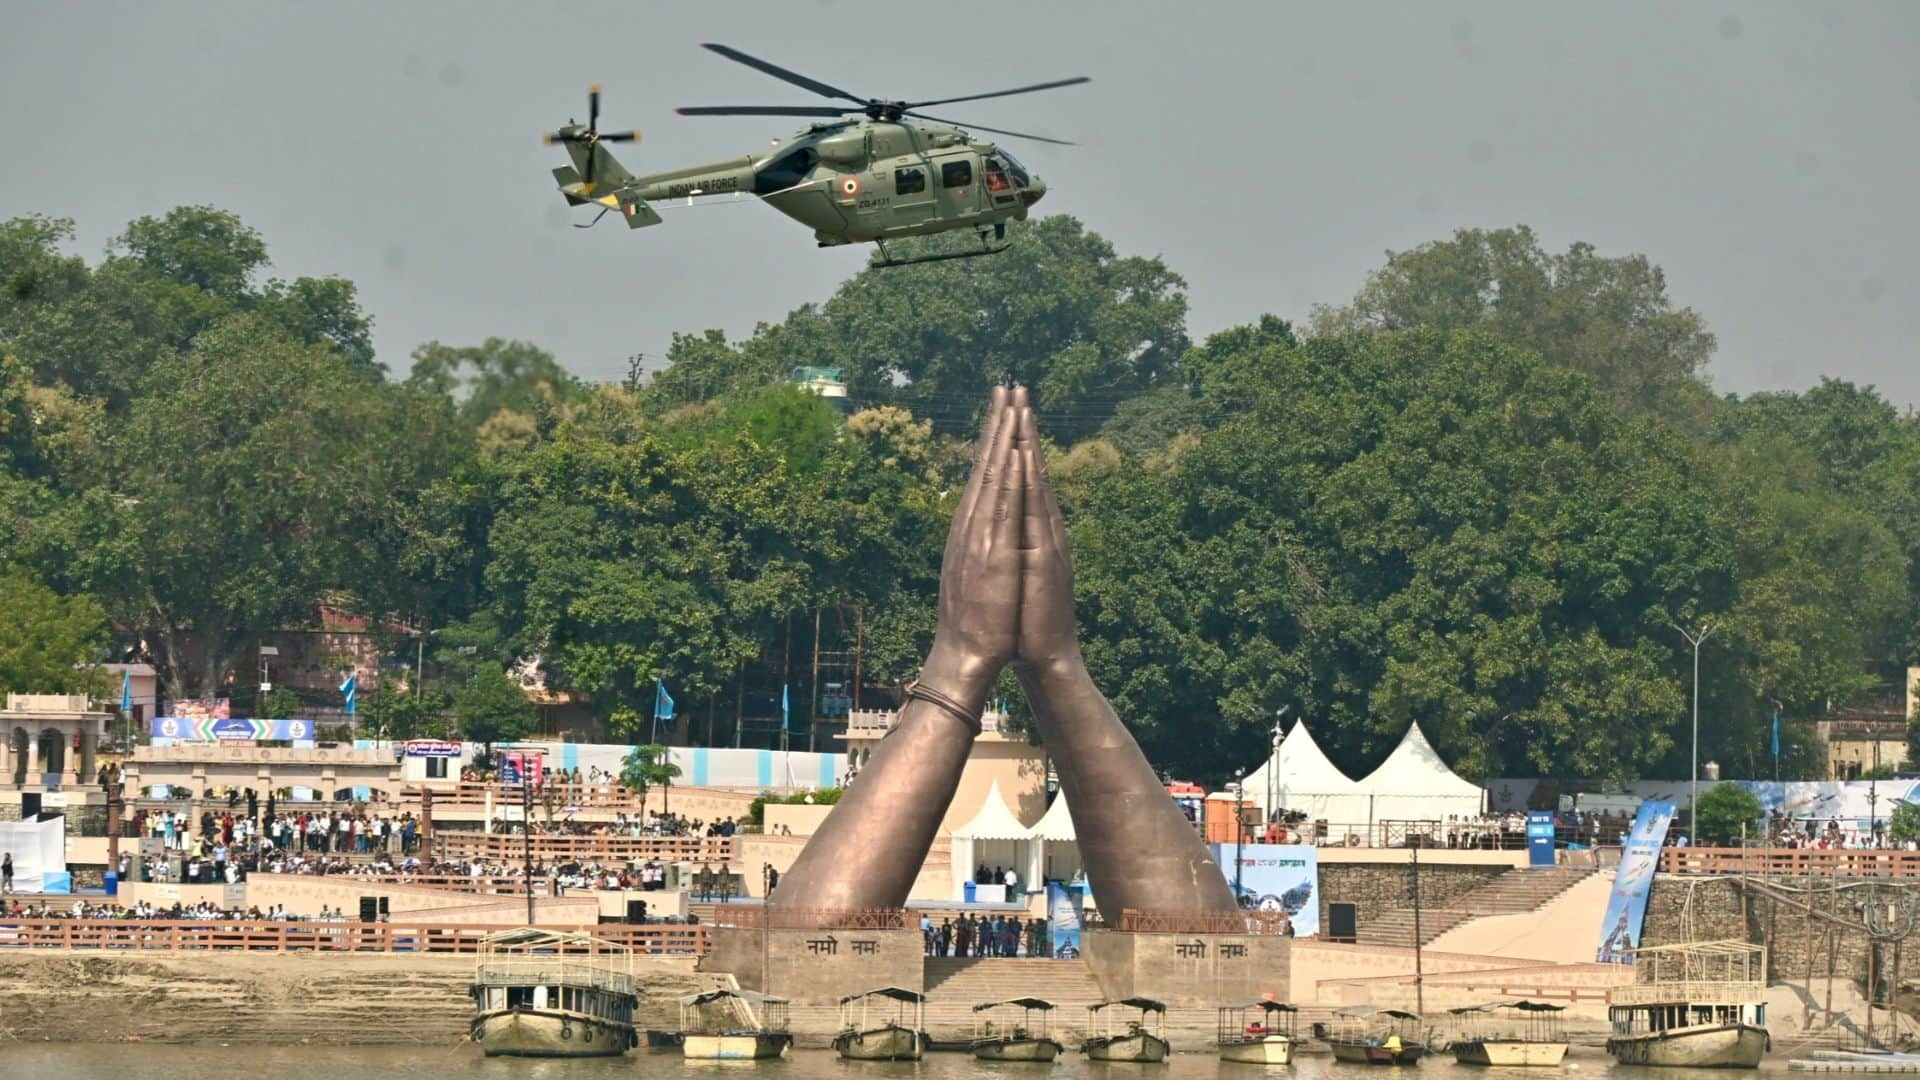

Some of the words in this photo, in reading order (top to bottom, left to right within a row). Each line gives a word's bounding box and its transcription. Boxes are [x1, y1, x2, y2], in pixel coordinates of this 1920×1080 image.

[670, 182, 695, 195] INDIAN
[697, 180, 710, 192] AIR
[712, 176, 737, 189] FORCE
[806, 936, 838, 955] नमो
[850, 940, 880, 955] नमः
[1175, 939, 1206, 959] नमो
[1219, 944, 1249, 959] नमः
